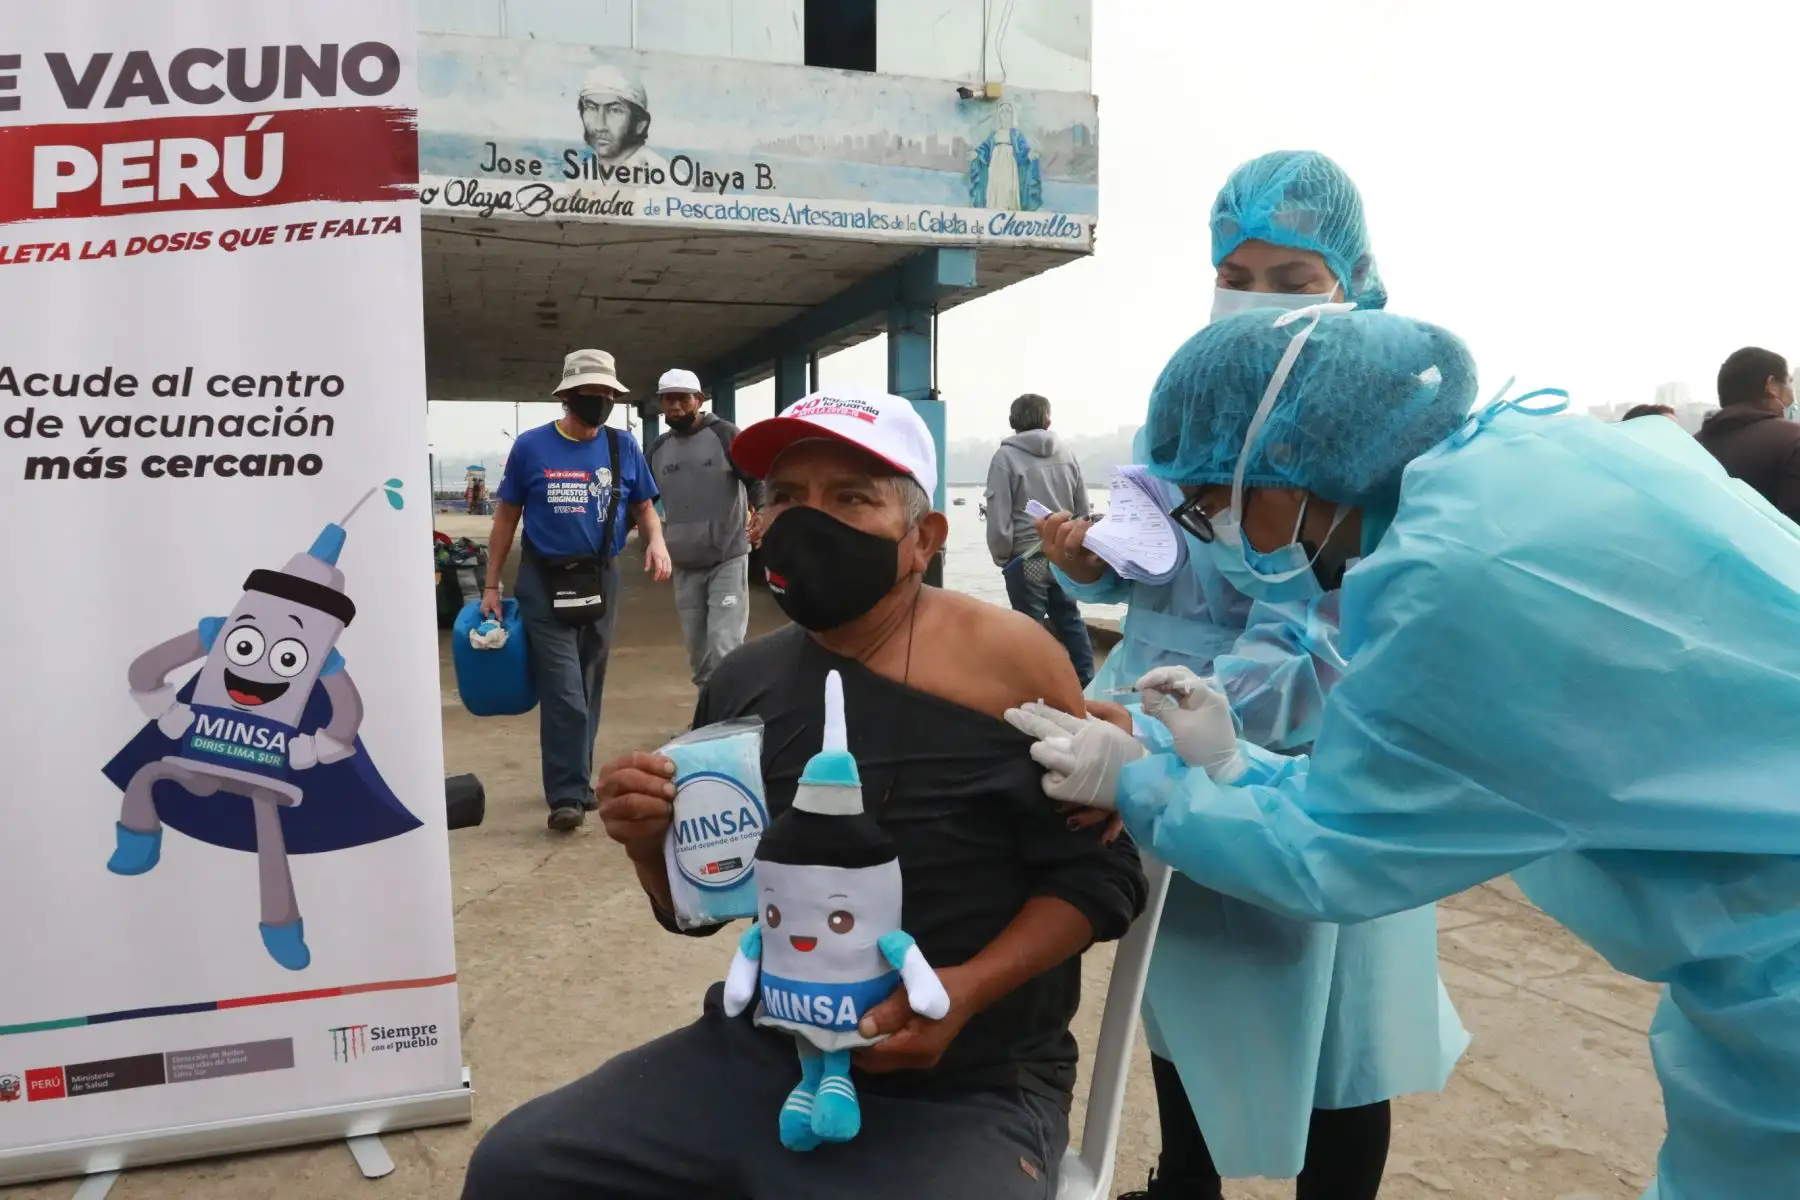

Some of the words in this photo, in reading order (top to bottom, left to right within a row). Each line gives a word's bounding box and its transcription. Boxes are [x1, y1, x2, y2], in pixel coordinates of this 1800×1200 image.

[45, 41, 400, 110] VACUNO
[32, 115, 284, 209] PERÚ
[480, 142, 542, 176] Jose
[562, 149, 664, 186] Silverio
[669, 154, 745, 194] Olaya
[755, 163, 776, 190] B.
[444, 179, 514, 218] Olaya
[643, 201, 661, 216] de
[666, 196, 780, 223] Pescadores
[780, 203, 889, 230] Artesanales
[890, 216, 904, 231] de
[918, 210, 967, 235] Caleta
[971, 220, 984, 236] de
[988, 212, 1082, 239] Chorrillos
[79, 239, 116, 260] LA
[125, 230, 213, 256] DOSIS
[219, 226, 278, 251] QUE
[284, 221, 315, 242] TE
[320, 216, 401, 239] FALTA
[0, 366, 138, 397] Acude
[152, 366, 194, 397] al
[206, 370, 344, 397] centro
[4, 408, 64, 439] de
[80, 406, 334, 438] vacunación
[24, 447, 127, 480] más
[141, 452, 323, 479] cercano
[195, 713, 286, 754] MINSA
[194, 738, 225, 753] DIRIS
[227, 746, 255, 761] LIMA
[259, 753, 281, 767] SUR
[699, 838, 729, 849] depende
[764, 985, 858, 1025] MINSA
[371, 1024, 438, 1041] Siempre
[395, 1036, 438, 1053] pueblo
[31, 1076, 61, 1090] PERÚ
[71, 1072, 115, 1083] Ministerio
[71, 1083, 84, 1092] de
[85, 1080, 109, 1090] Salud
